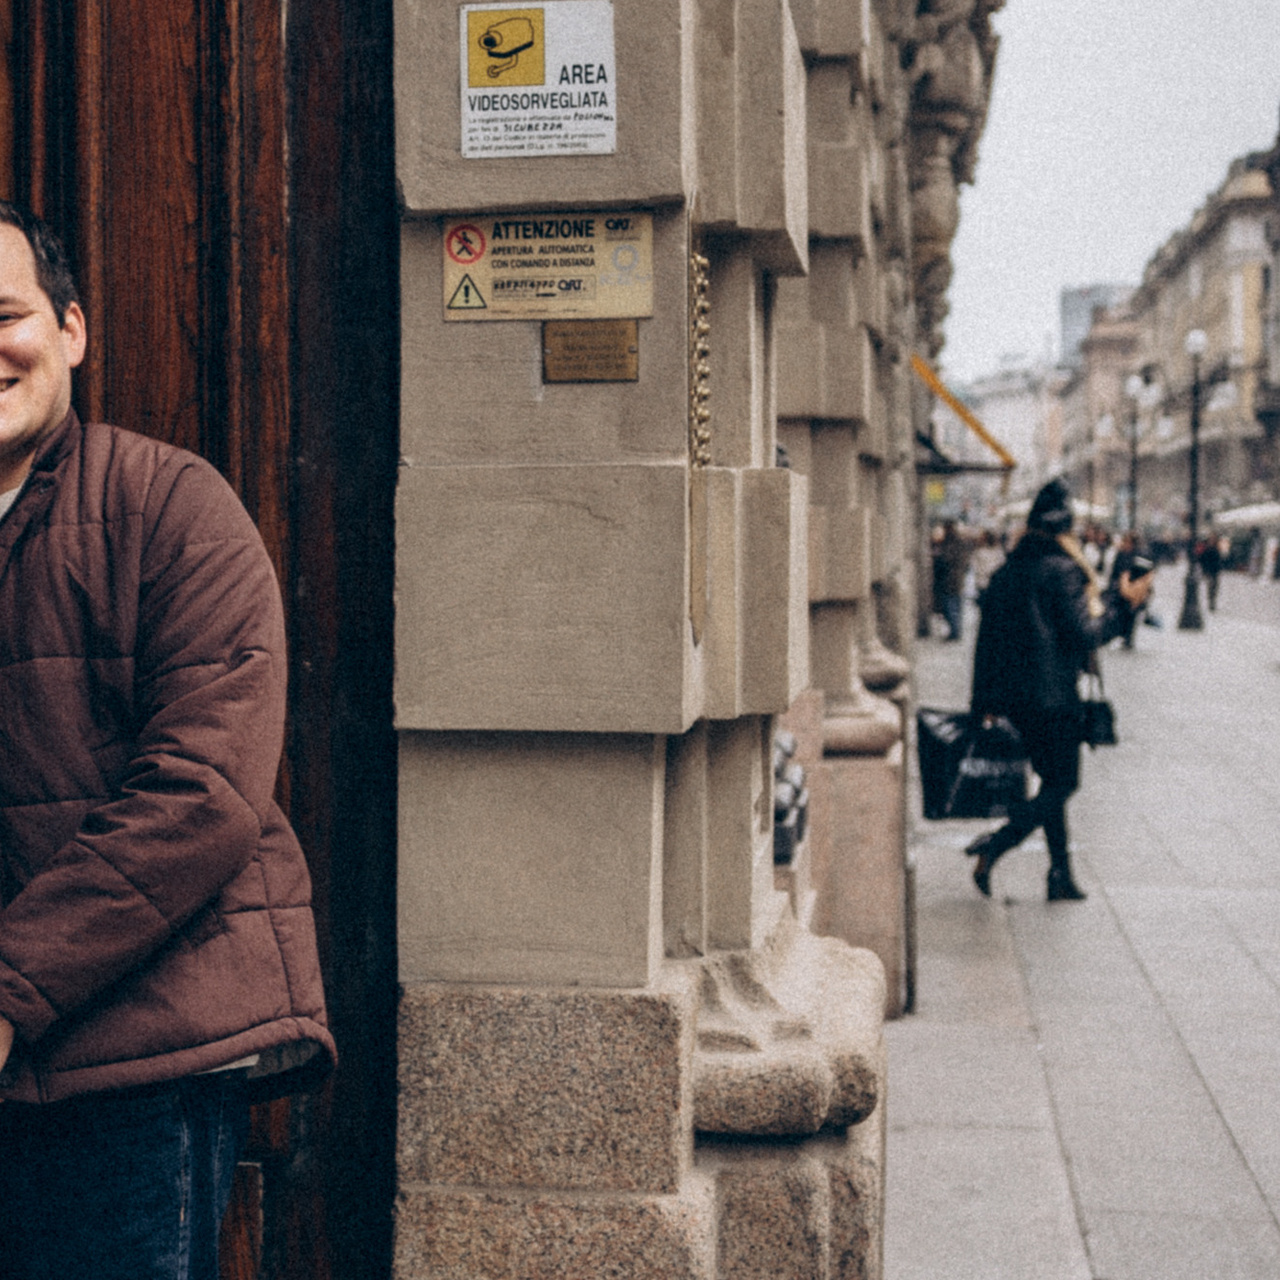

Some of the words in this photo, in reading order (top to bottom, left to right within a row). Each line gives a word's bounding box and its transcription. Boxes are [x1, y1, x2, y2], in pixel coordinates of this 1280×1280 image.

[559, 64, 608, 85] AREA
[468, 91, 609, 112] VIDEOSORVEGLIATA
[491, 219, 596, 240] ATTENZIONE
[491, 245, 534, 256] APERTURA
[538, 244, 595, 255] AUTOMATICA
[491, 259, 509, 269] CON
[510, 258, 551, 269] COMANDO
[552, 258, 558, 268] A
[559, 257, 595, 268] DISTANZA
